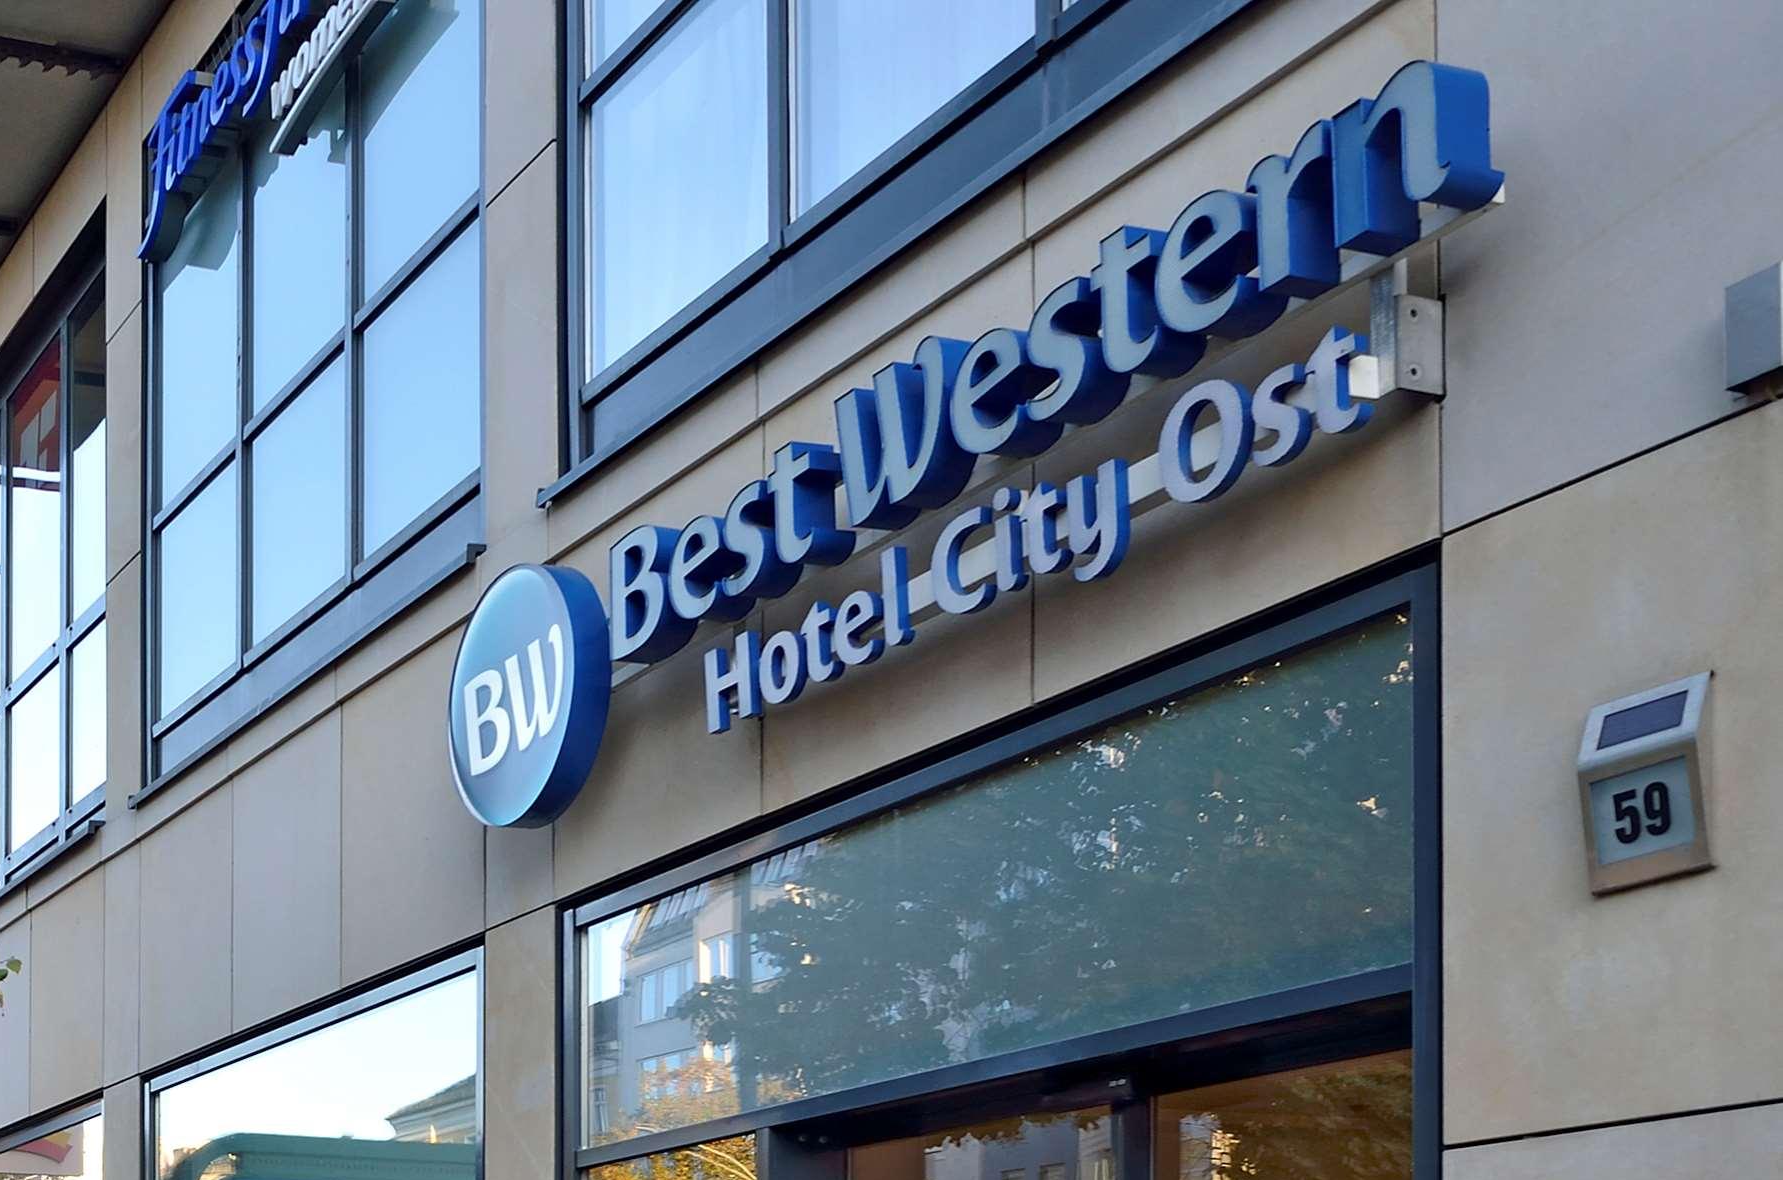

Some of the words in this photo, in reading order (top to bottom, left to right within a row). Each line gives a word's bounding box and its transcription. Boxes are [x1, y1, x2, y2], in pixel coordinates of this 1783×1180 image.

[609, 441, 843, 662] Best
[834, 61, 1493, 528] Western
[704, 546, 913, 735] Hotel
[930, 457, 1130, 615] City
[1159, 324, 1373, 503] Ost
[464, 623, 565, 777] BW
[1612, 781, 1672, 845] 59
